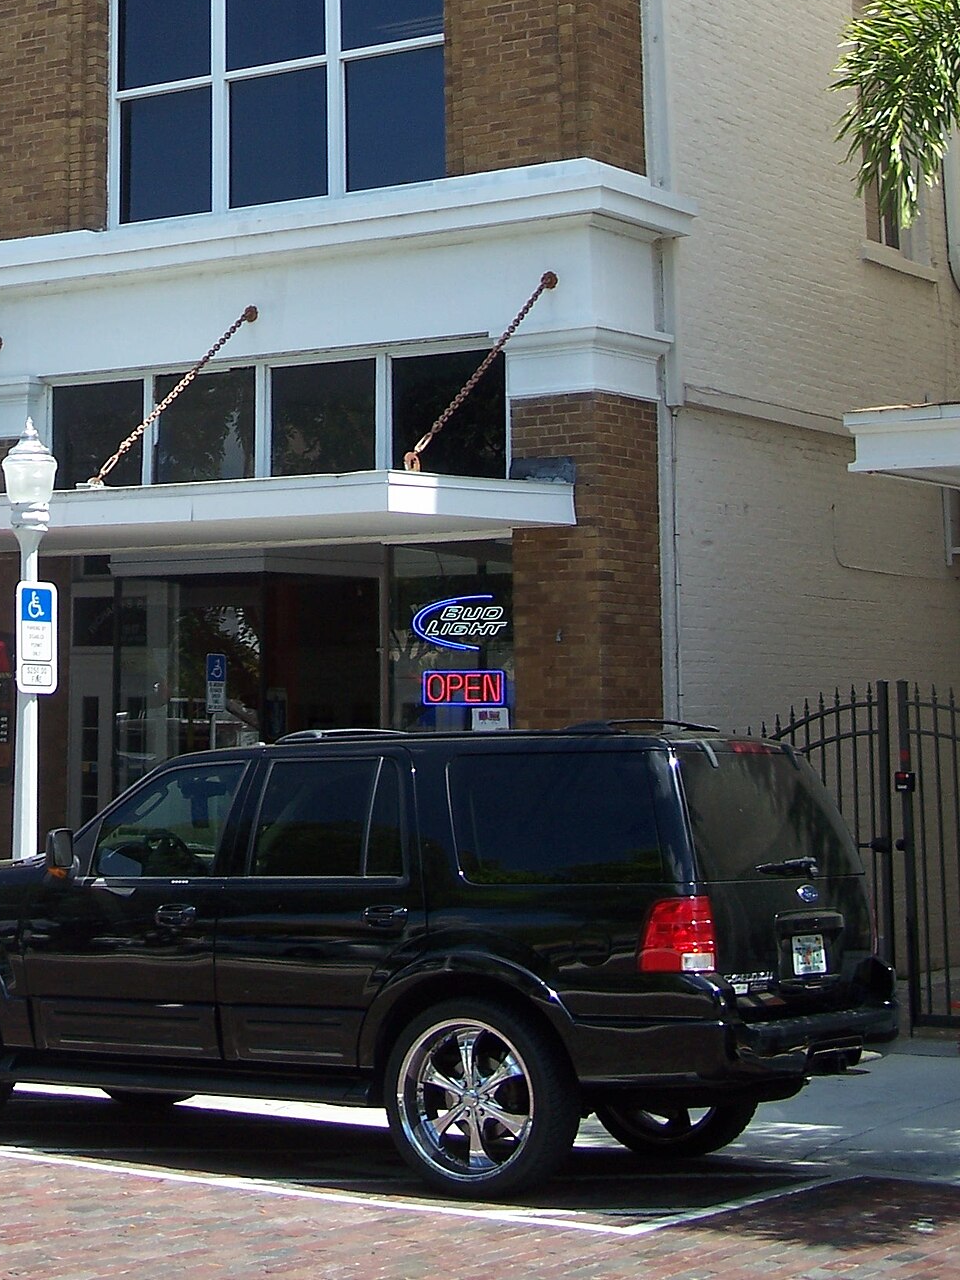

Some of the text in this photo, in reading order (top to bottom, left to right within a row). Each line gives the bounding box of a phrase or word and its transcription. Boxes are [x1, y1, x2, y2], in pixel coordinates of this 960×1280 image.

[440, 606, 504, 621] BUD
[425, 620, 508, 636] LIGHT
[427, 673, 501, 702] OPEN
